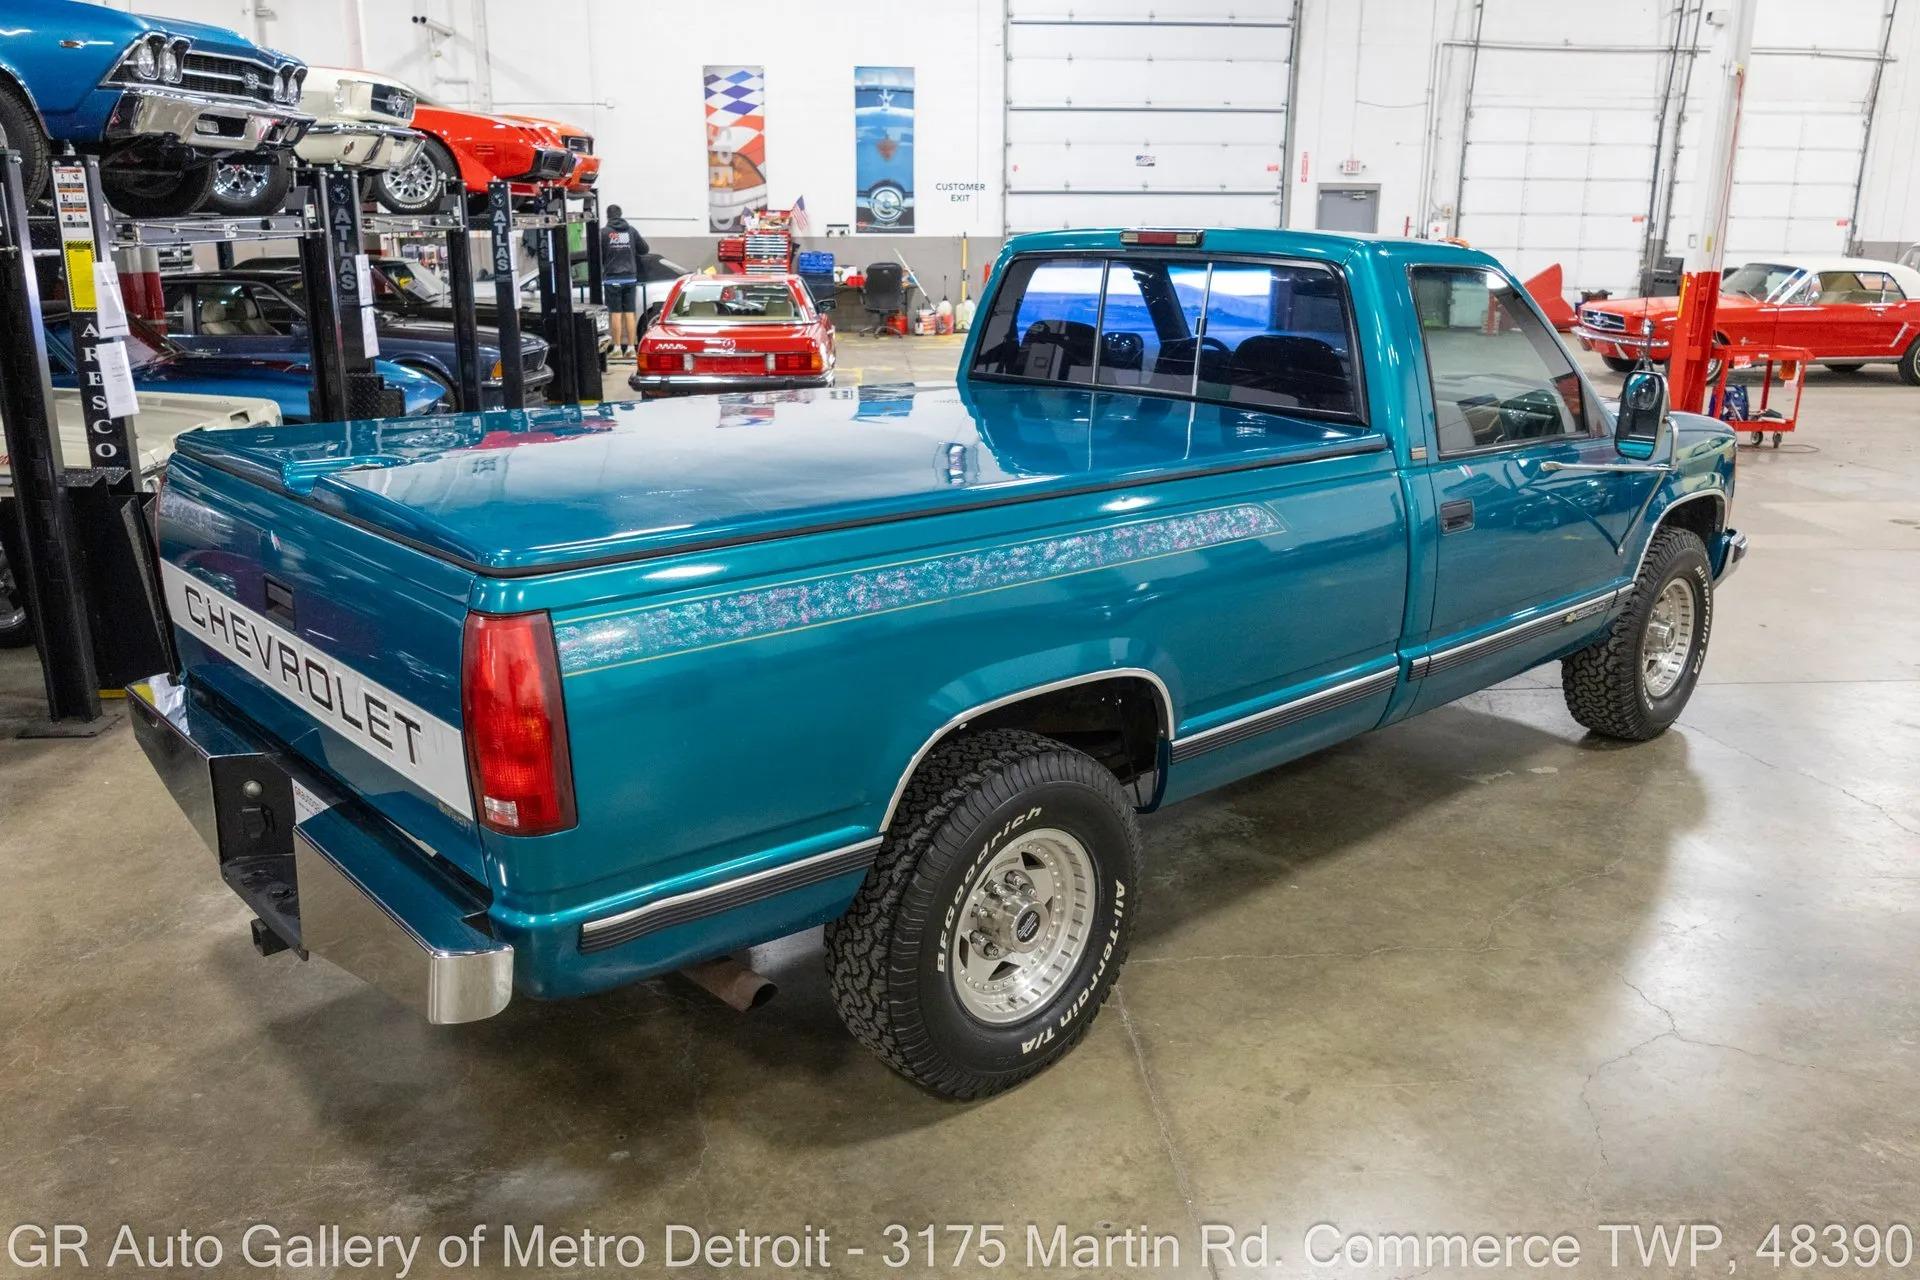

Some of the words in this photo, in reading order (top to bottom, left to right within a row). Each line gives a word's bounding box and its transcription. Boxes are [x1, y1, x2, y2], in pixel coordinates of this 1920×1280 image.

[935, 183, 986, 191] CUSTOMER
[951, 194, 970, 202] EXIT
[335, 207, 357, 291] ATLAS
[493, 209, 509, 271] ATLAS
[185, 585, 422, 766] CHEVROLET
[1060, 879, 1126, 1028] All-Terrain
[1021, 1031, 1056, 1054] T/A
